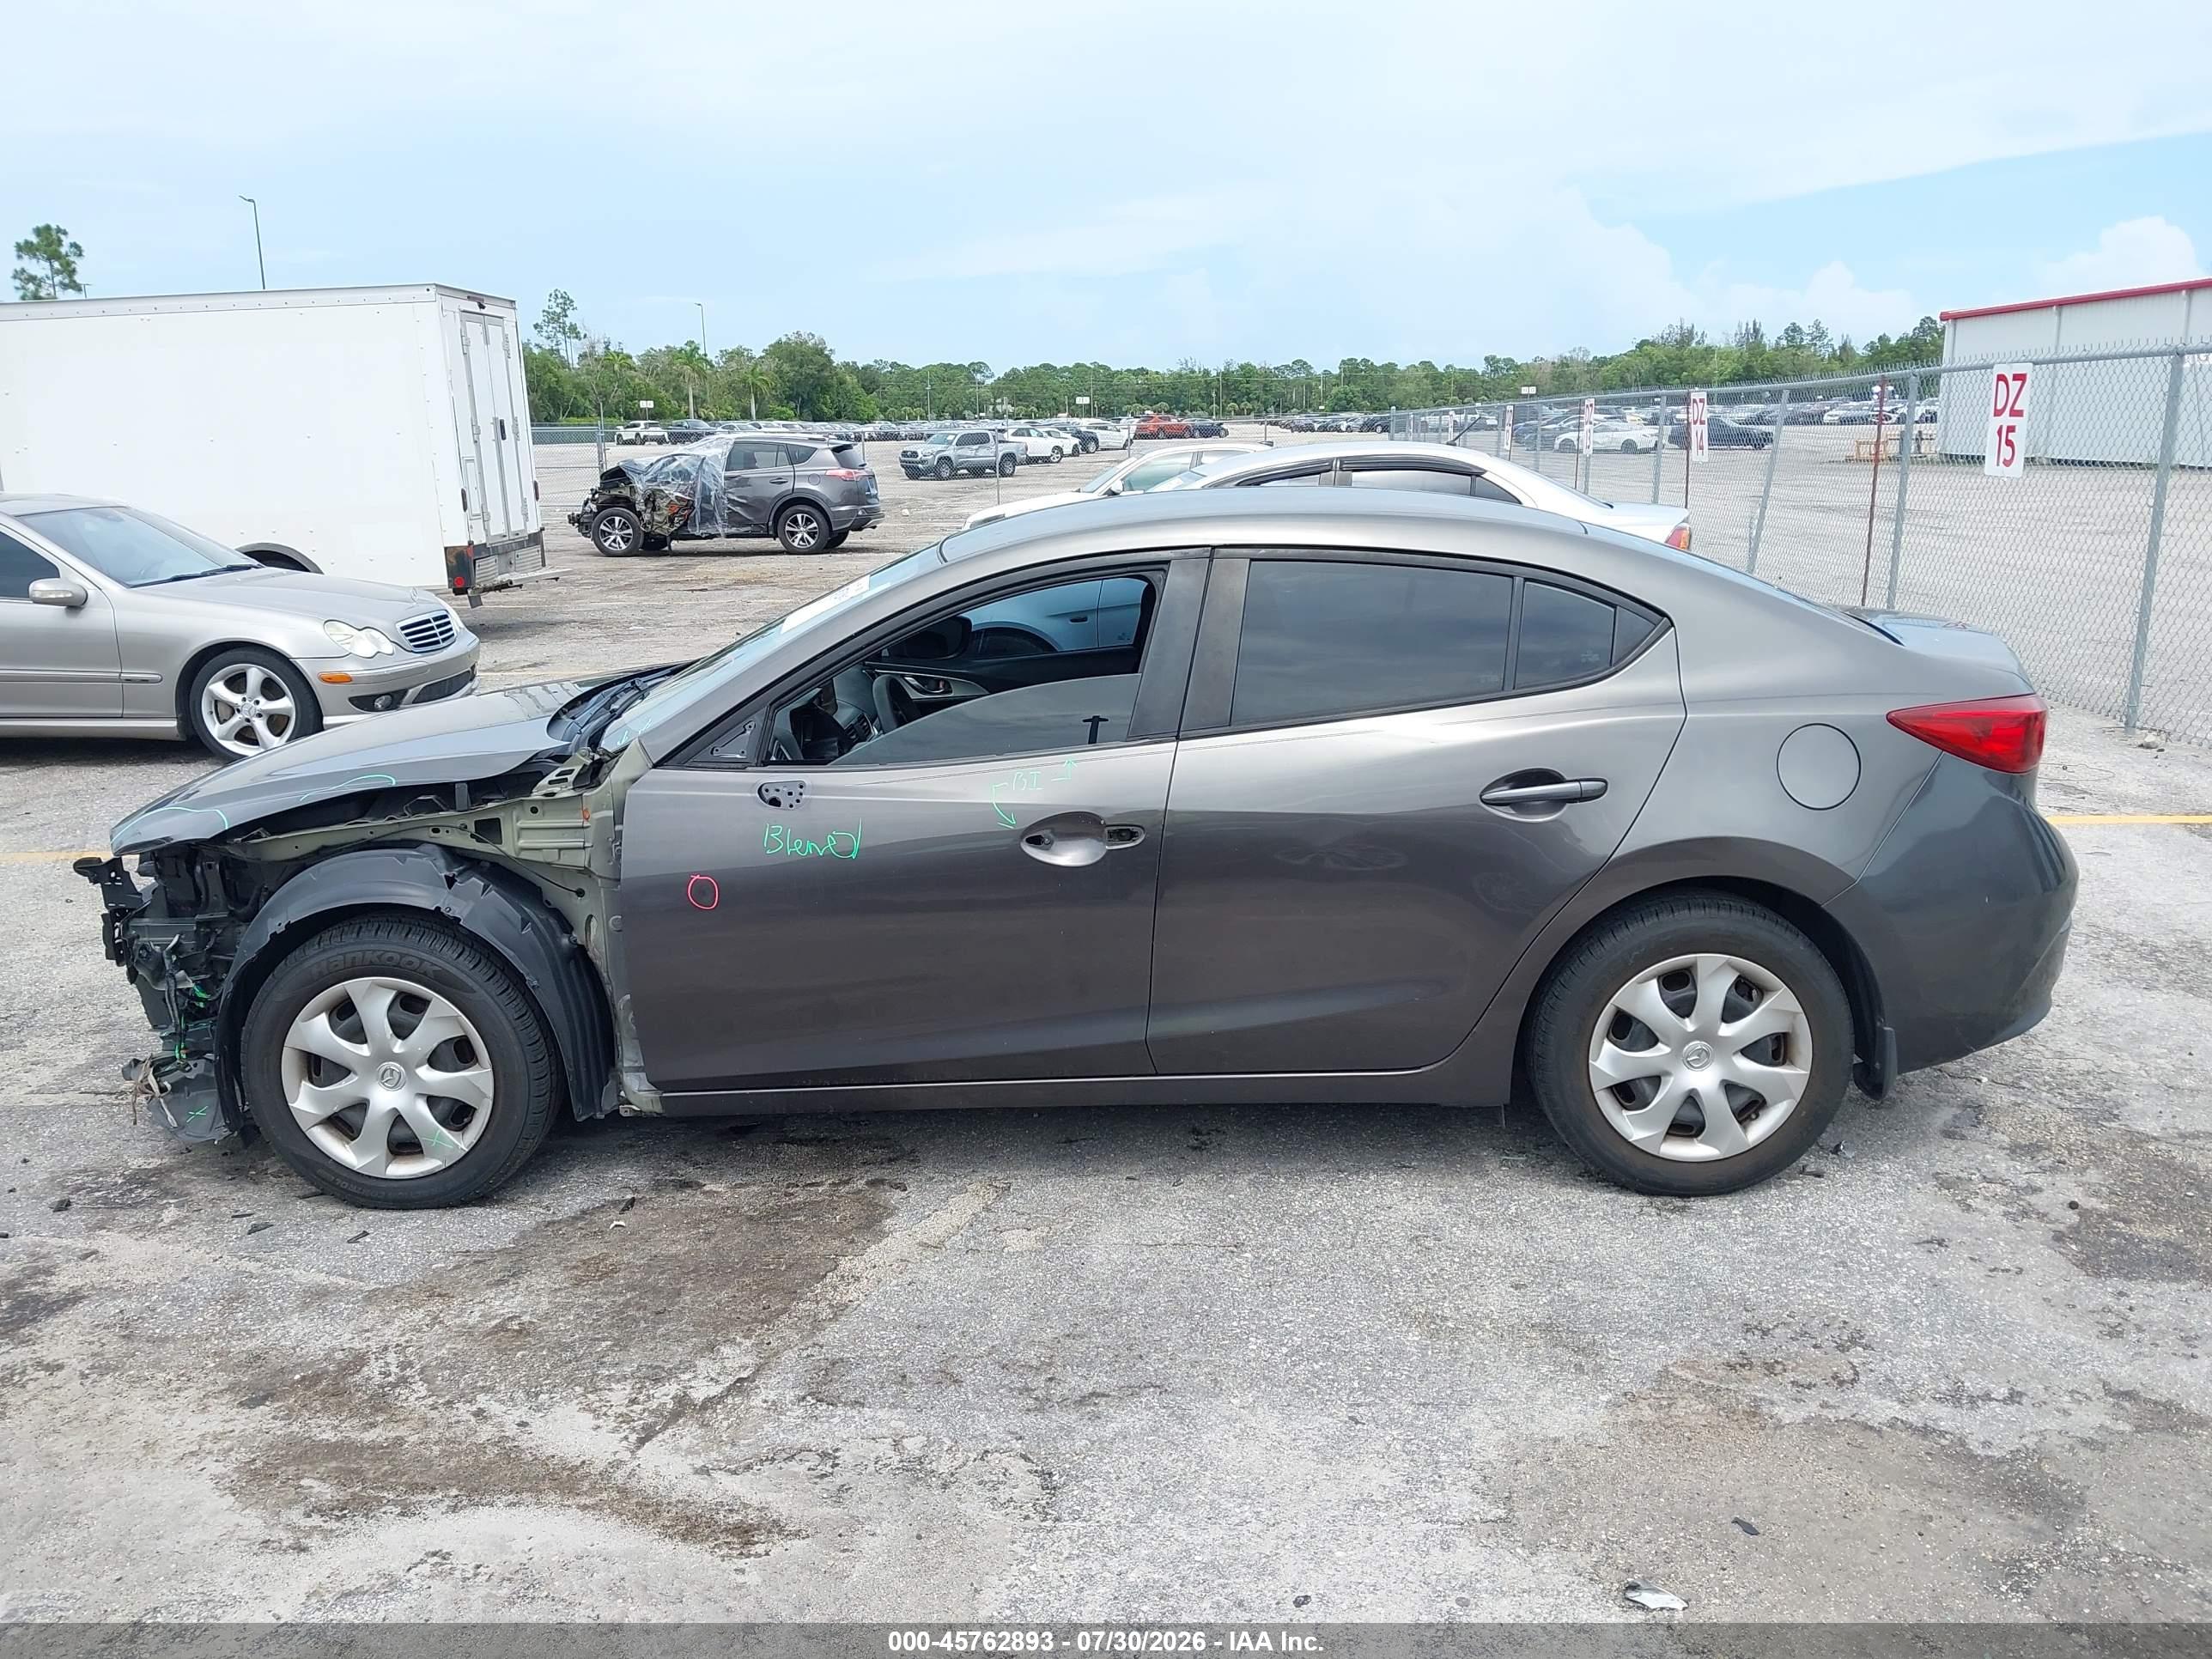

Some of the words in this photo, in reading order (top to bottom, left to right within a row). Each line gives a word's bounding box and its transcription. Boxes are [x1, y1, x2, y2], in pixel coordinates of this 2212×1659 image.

[1692, 398, 1706, 426] DZ
[1994, 373, 2027, 417] DZ
[1695, 429, 1705, 457] 14
[1996, 425, 2017, 468] 15
